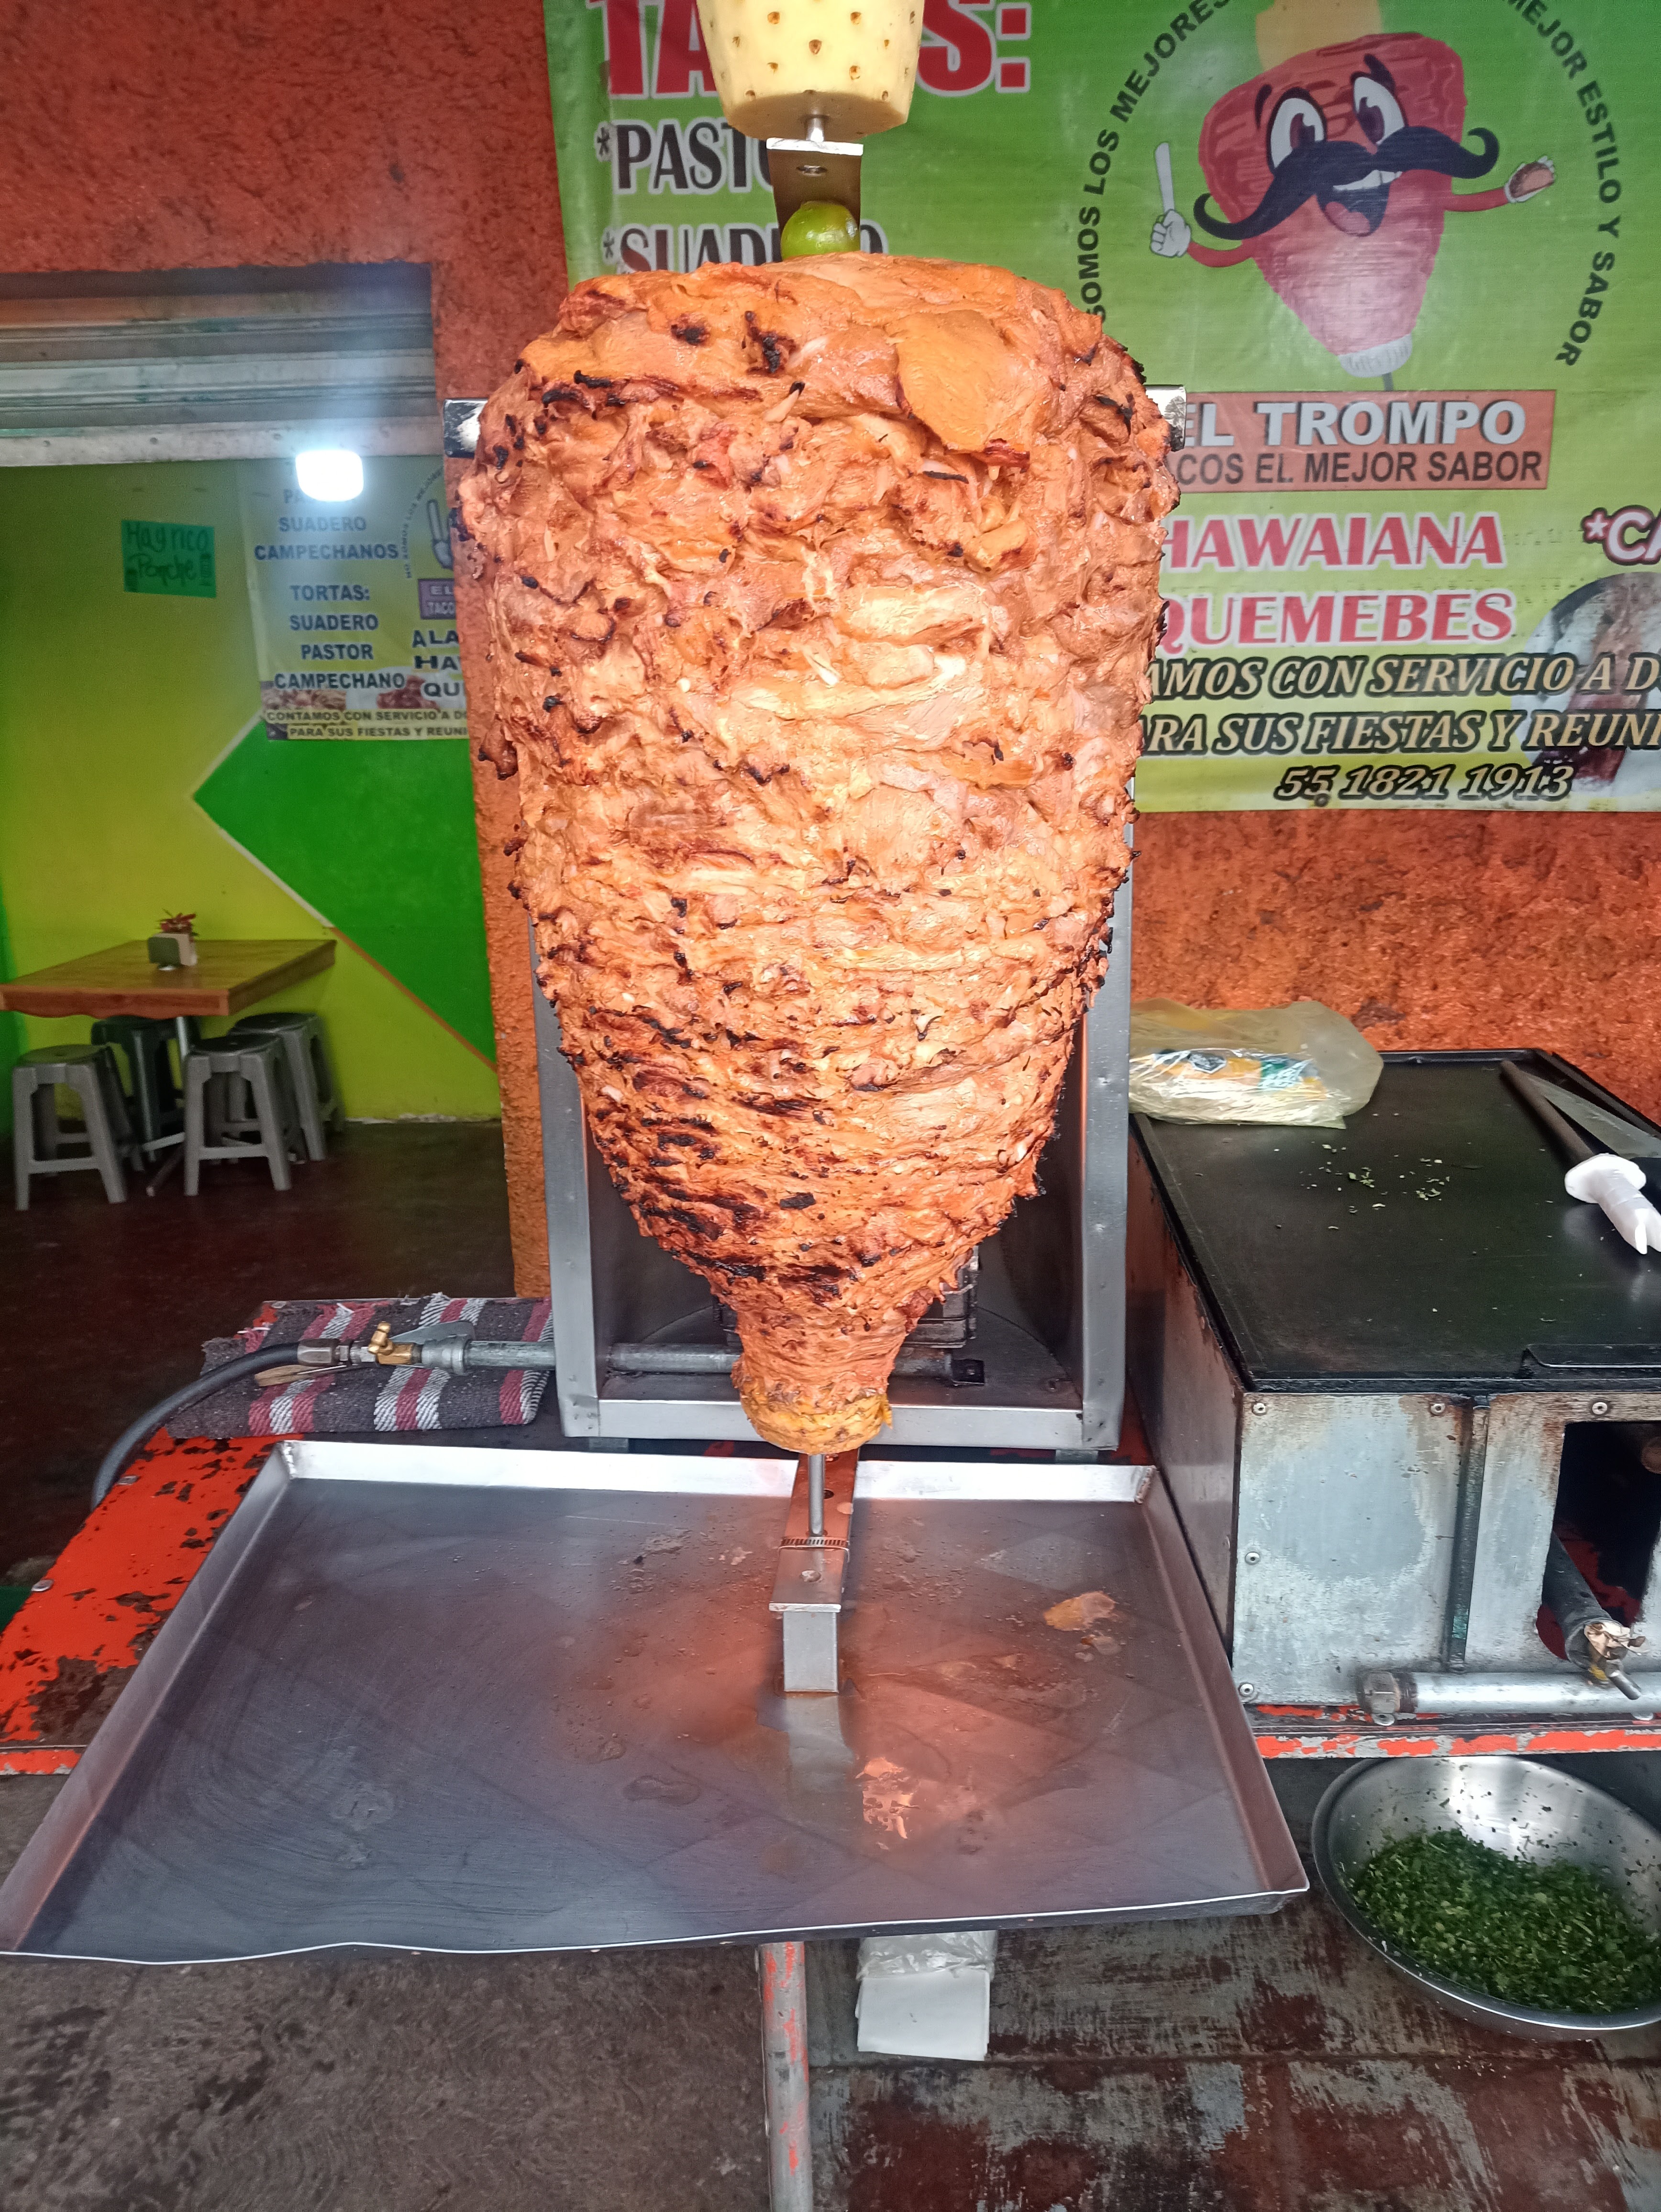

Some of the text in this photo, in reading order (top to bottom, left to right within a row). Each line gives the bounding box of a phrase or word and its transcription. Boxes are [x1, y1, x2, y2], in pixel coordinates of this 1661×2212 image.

[1577, 80, 1622, 203] ESTILO
[1083, 129, 1119, 195] LOS
[1597, 215, 1621, 238] Y
[1555, 251, 1615, 365] SABOR
[1253, 400, 1526, 446] TROMPO
[1255, 453, 1294, 484] EL
[1304, 451, 1417, 483] MEJOR
[1427, 450, 1542, 482] SABOR
[278, 517, 366, 532] SUADERO
[255, 545, 398, 560] CAMPECHANOS
[1163, 517, 1504, 568] HAWAIANA
[291, 585, 370, 600] TORTAS:
[290, 615, 379, 630] SUADERO
[1160, 593, 1512, 654] QUEMEBES
[301, 644, 374, 660] PASTOR
[415, 655, 461, 670] HA
[275, 674, 405, 689] CAMPECHANO
[1271, 659, 1371, 697] CON
[1372, 657, 1576, 695] SERVICIO
[1581, 656, 1612, 692] A
[266, 712, 339, 721] CONTAMOS
[344, 712, 372, 721] CON
[377, 711, 437, 720] SERVICIO
[441, 711, 450, 719] A
[290, 728, 323, 737] PARA
[328, 728, 353, 737] SUS
[357, 727, 410, 736] FIESTAS
[415, 727, 422, 736] Y
[1140, 715, 1204, 752] RA
[1214, 715, 1302, 751] SUS
[1305, 713, 1485, 751] FIESTAS
[1492, 714, 1525, 749] Y
[1275, 764, 1575, 799] 55 1821 1913
